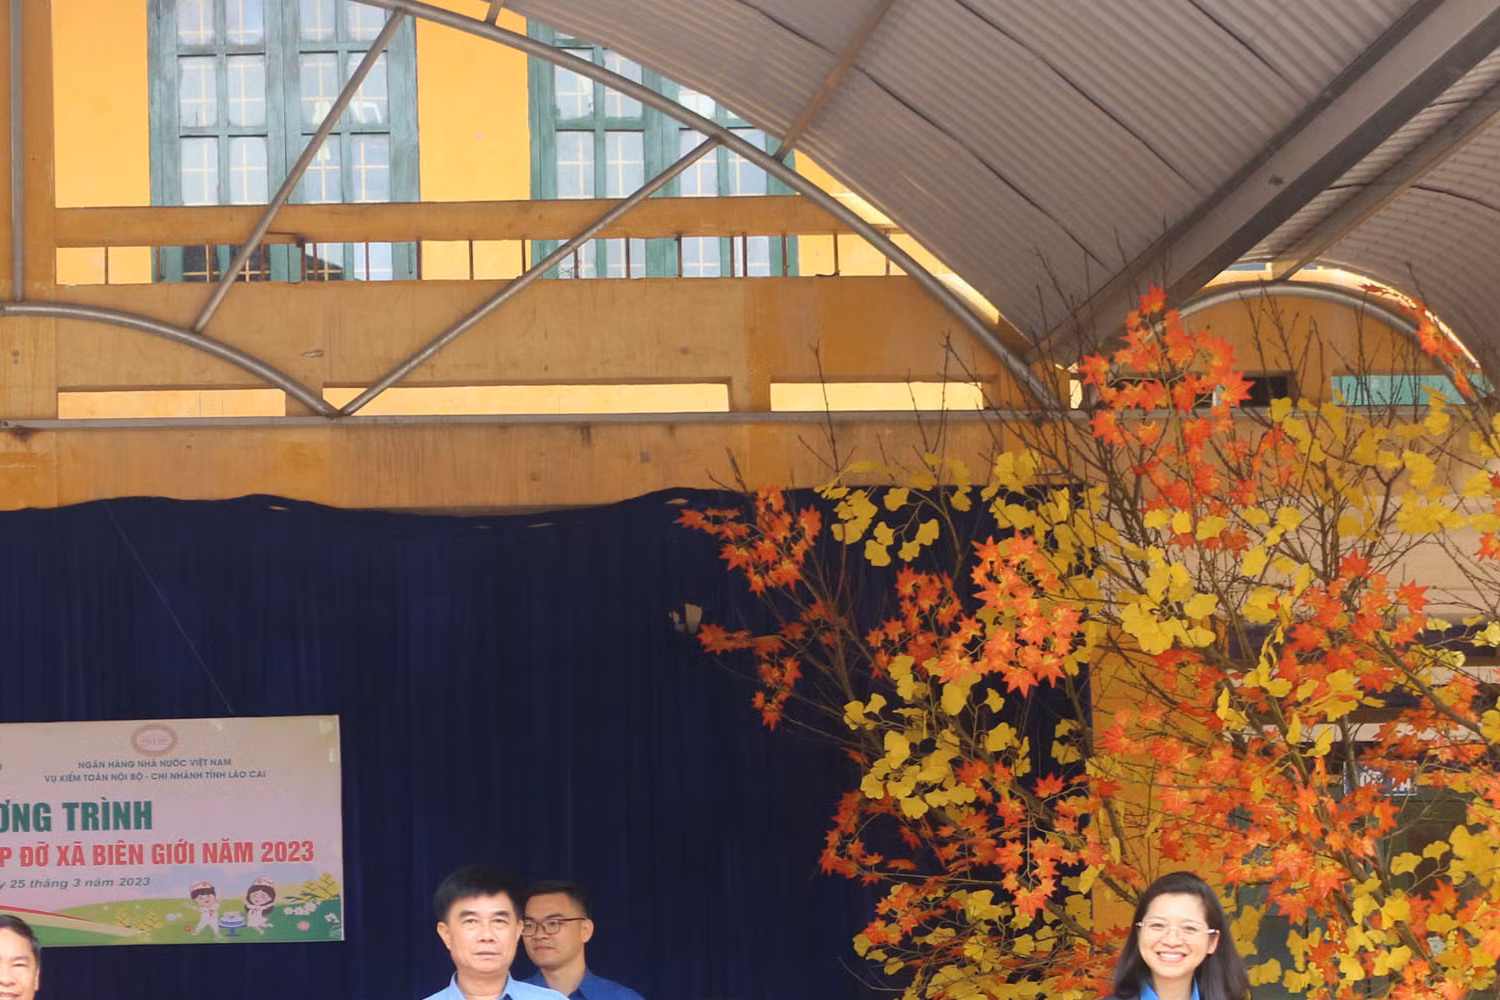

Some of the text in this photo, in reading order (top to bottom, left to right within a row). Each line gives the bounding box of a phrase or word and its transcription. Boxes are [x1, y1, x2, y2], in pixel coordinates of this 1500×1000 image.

[210, 758, 231, 766] NAM
[151, 772, 167, 780] CHI
[249, 770, 266, 778] CAI
[62, 797, 153, 832] TRÌNH
[20, 841, 50, 868] ĐỠ
[56, 841, 86, 867] XÃ
[92, 839, 144, 866] BIÊN
[151, 838, 195, 865] GIỚI
[202, 838, 254, 864] NĂM
[261, 840, 315, 863] 2023
[10, 879, 26, 889] 25
[30, 878, 68, 890] tháng
[73, 878, 81, 887] 3
[84, 877, 114, 887] năm
[119, 877, 151, 887] 2023
